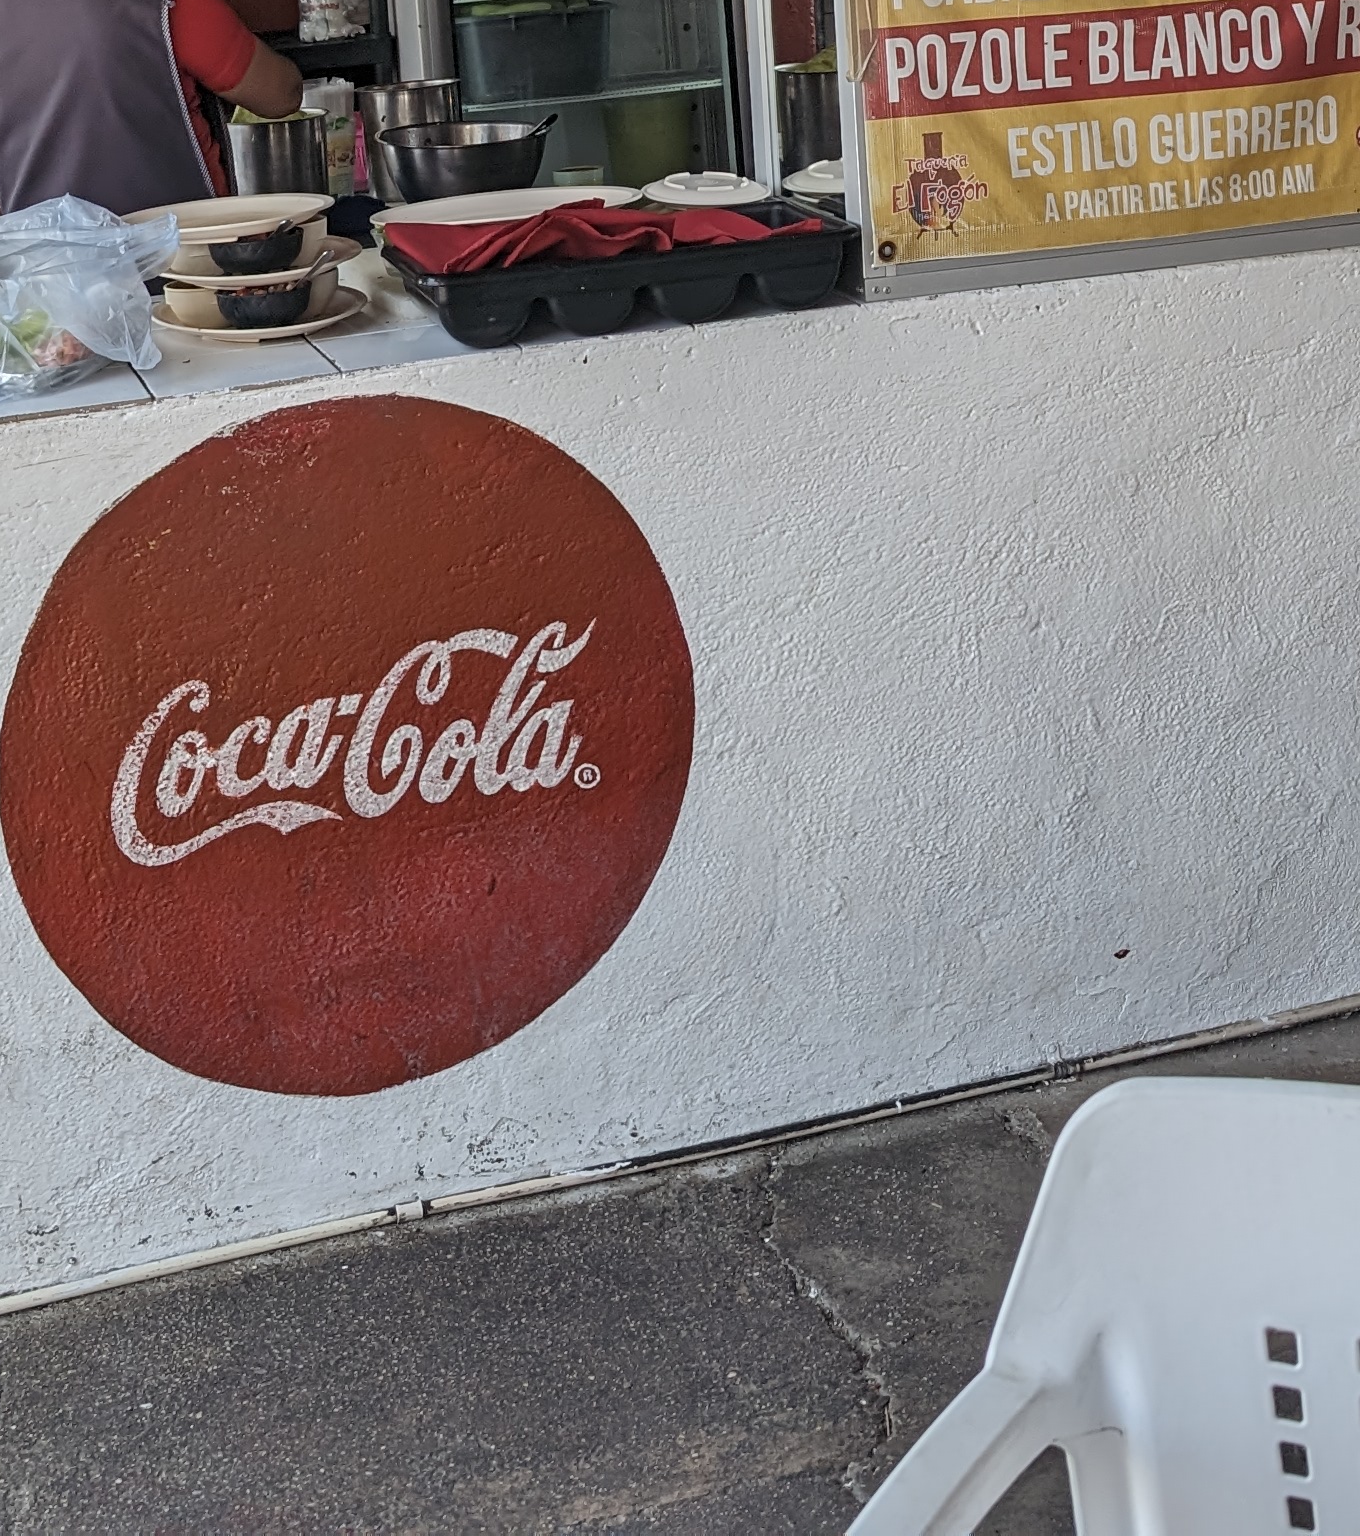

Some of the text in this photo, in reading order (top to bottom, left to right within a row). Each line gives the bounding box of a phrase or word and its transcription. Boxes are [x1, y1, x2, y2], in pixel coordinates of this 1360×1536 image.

[885, 24, 1072, 104] POZOLE
[1087, 2, 1283, 87] BLANCO
[1291, 0, 1326, 66] Y
[1007, 96, 1338, 179] ESTILO GUERRERO
[891, 173, 989, 222] El Fogón
[1045, 165, 1316, 223] A PARTIR DE LAS 8:00 AM
[111, 617, 597, 866] Coca-Cola
